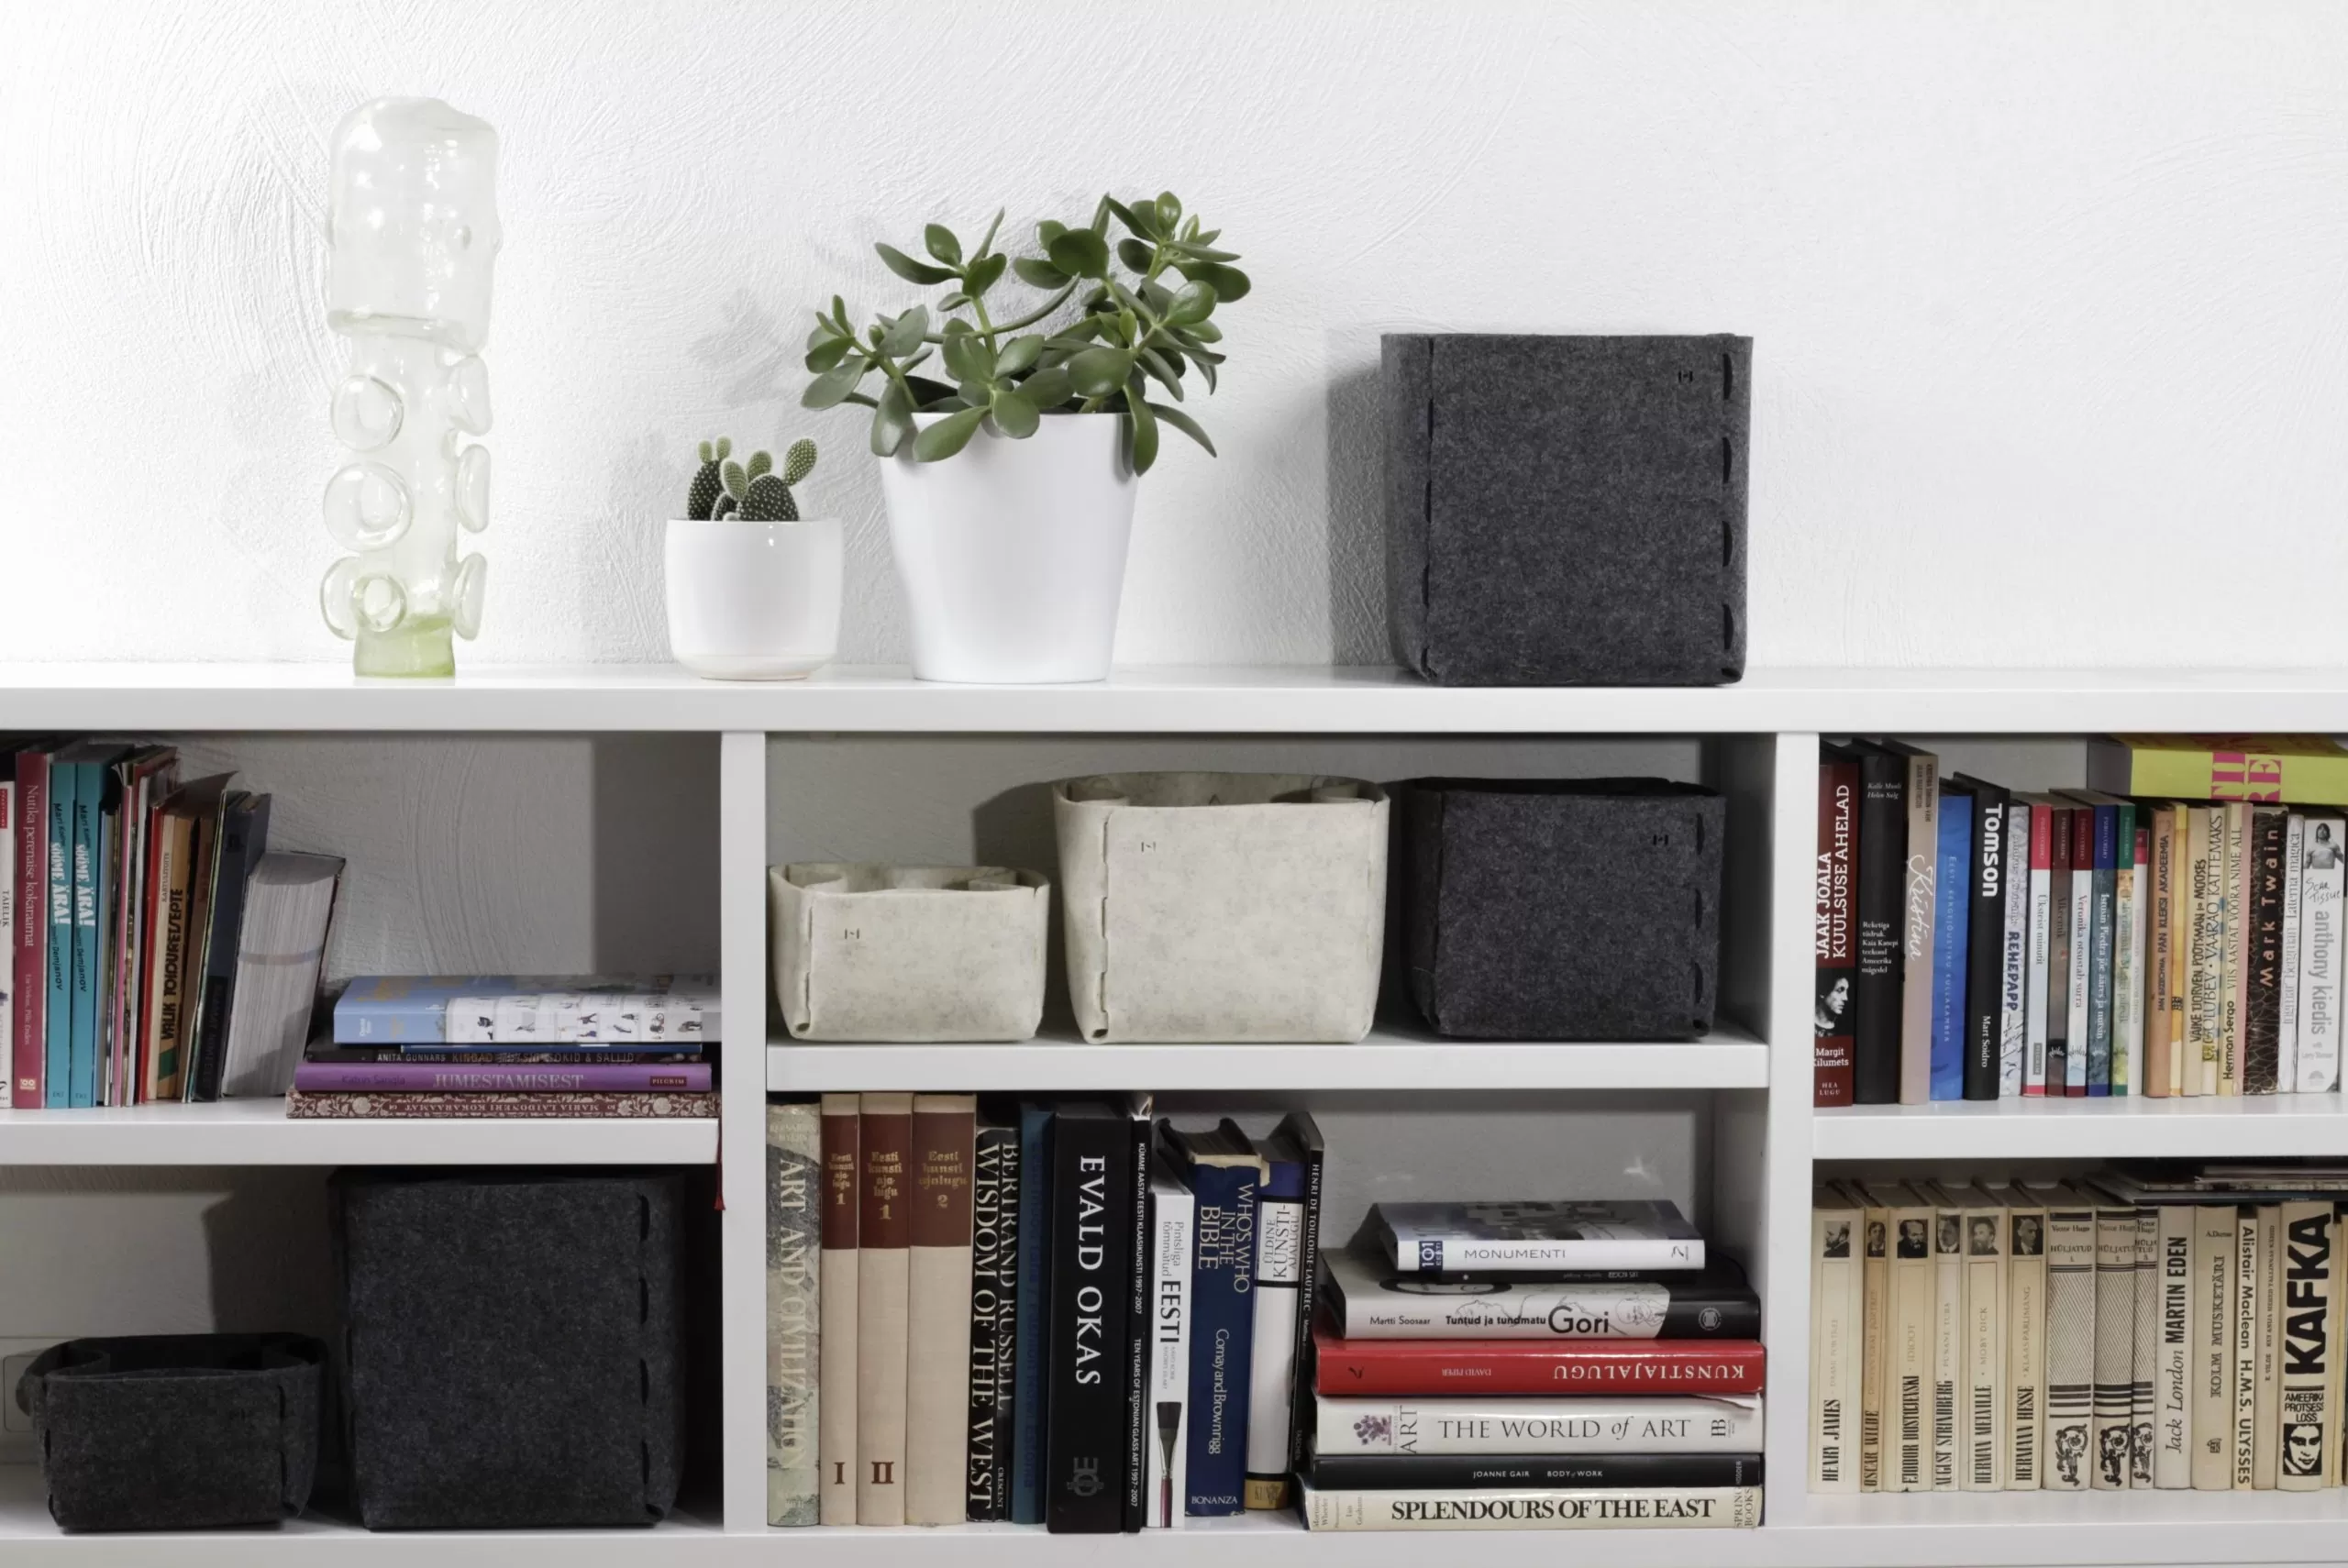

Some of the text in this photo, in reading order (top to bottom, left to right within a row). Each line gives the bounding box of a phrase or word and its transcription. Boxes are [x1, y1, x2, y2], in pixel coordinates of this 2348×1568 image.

[54, 802, 64, 824] Mari
[79, 804, 89, 826] Mari
[23, 785, 39, 945] Nutika perenaise kokaraamat
[1833, 785, 1850, 958] KUULSUSE AHELAD
[1981, 803, 2003, 898] Tomson
[2206, 815, 2222, 897] KATTEMAKS
[2289, 833, 2301, 872] magica
[50, 842, 72, 924] SÖÖME ÄRA!
[75, 844, 95, 925] SÖÖME ÄRA!
[1816, 852, 1832, 959] JAAK JOALA
[1906, 855, 1934, 961] Kristina
[2158, 834, 2169, 954] PAN KLEKSI AKADEEMIA
[2259, 830, 2278, 988] Mark Twain
[2035, 894, 2048, 966] Üksteist minutit
[2056, 895, 2066, 939] Alkeemik
[2076, 895, 2088, 938] Veronika
[52, 945, 63, 990] Demjanov
[77, 947, 88, 991] Demjanov
[161, 889, 183, 1043] VALIK TOIDURETSEPTE
[2006, 931, 2021, 1011] REHEPAPP
[2076, 941, 2086, 980] otsustab
[2096, 893, 2110, 1008] Istusin Piedra ääres ja
[2189, 859, 2206, 1043] VÄIKE MOOSES
[2222, 826, 2243, 1080] Herman Sergo VIIS AASTAT VÕÕRA NIME ALL
[2308, 911, 2334, 978] anthony
[2311, 986, 2333, 1035] kiedis
[377, 1053, 635, 1062] ANITA GUNNARS SALLID
[1816, 1047, 1844, 1058] Margit
[1981, 1015, 1991, 1068] Mart Soidro
[432, 1074, 584, 1088] JUMESTAMISEST
[780, 1158, 806, 1209] ART
[1137, 1143, 1146, 1171] KÜMME
[836, 1193, 846, 1205] 1
[879, 1204, 892, 1220] 1
[937, 1194, 948, 1209] 2
[1136, 1200, 1145, 1220] EESTI
[780, 1226, 806, 1286] AND
[1135, 1221, 1144, 1274] KLAASIKUNSTI
[1161, 1221, 1173, 1276] tõmmatud
[1170, 1221, 1185, 1266] Pintsliga
[1199, 1205, 1222, 1270] BIBLE
[1219, 1211, 1235, 1265] IN THE
[1262, 1218, 1276, 1264] ÜLDINE
[1272, 1204, 1290, 1278] KUNSTI-
[1288, 1215, 1300, 1270] AJALUGU
[1303, 1164, 1320, 1311] HENRI DE TOULOUSE-LAUTREC
[1422, 1242, 1434, 1267] 101
[1464, 1249, 1567, 1259] MONUMENTI
[997, 1143, 1019, 1411] BERTRAND RUSSELL
[1075, 1154, 1106, 1385] EVALD OKAS
[1234, 1245, 1251, 1293] WHO
[2285, 1213, 2331, 1375] KAFKA
[969, 1143, 1000, 1508] WISDOM OF THE WEST
[1160, 1280, 1181, 1343] EESTI
[1369, 1315, 1431, 1325] Martti Soosaar
[1445, 1305, 1610, 1334] Tuntud ja tundmatu Gori
[1441, 1367, 1492, 1375] DAVID PIPER
[1554, 1364, 1745, 1379] KUNSTIAJALUGU
[2165, 1236, 2187, 1455] Jack London MARTIN EDEN
[2237, 1226, 2254, 1485] Alistair Maclean H.M.S. ULYSSES
[779, 1296, 806, 1467] CIVILIZATION
[1134, 1378, 1141, 1388] OF
[1209, 1329, 1230, 1454] Comay and Brownrigg
[1975, 1307, 1992, 1484] HERMAN MELVILLE MOBY DICK
[2210, 1353, 2223, 1398] KOLM
[1132, 1390, 1140, 1427] ESTONIAN
[1401, 1405, 1418, 1454] ART
[1437, 1416, 1692, 1441] THE WORLD of ART
[1935, 1381, 1954, 1486] AUGUST STRINDBERG
[2015, 1386, 2034, 1481] HERMANN HESSE
[2296, 1412, 2318, 1423] LOSS
[1131, 1452, 1139, 1466] ART
[1822, 1399, 1841, 1482] HENRY JAMES
[1864, 1410, 1879, 1486] OSCAR WILDE
[870, 1462, 894, 1485] II
[997, 1466, 1005, 1508] CRESCENT
[1473, 1470, 1507, 1478] JOANNE
[1191, 1496, 1238, 1505] BONANZA
[1390, 1498, 1717, 1521] SPLENDOURS OF THE EAST
